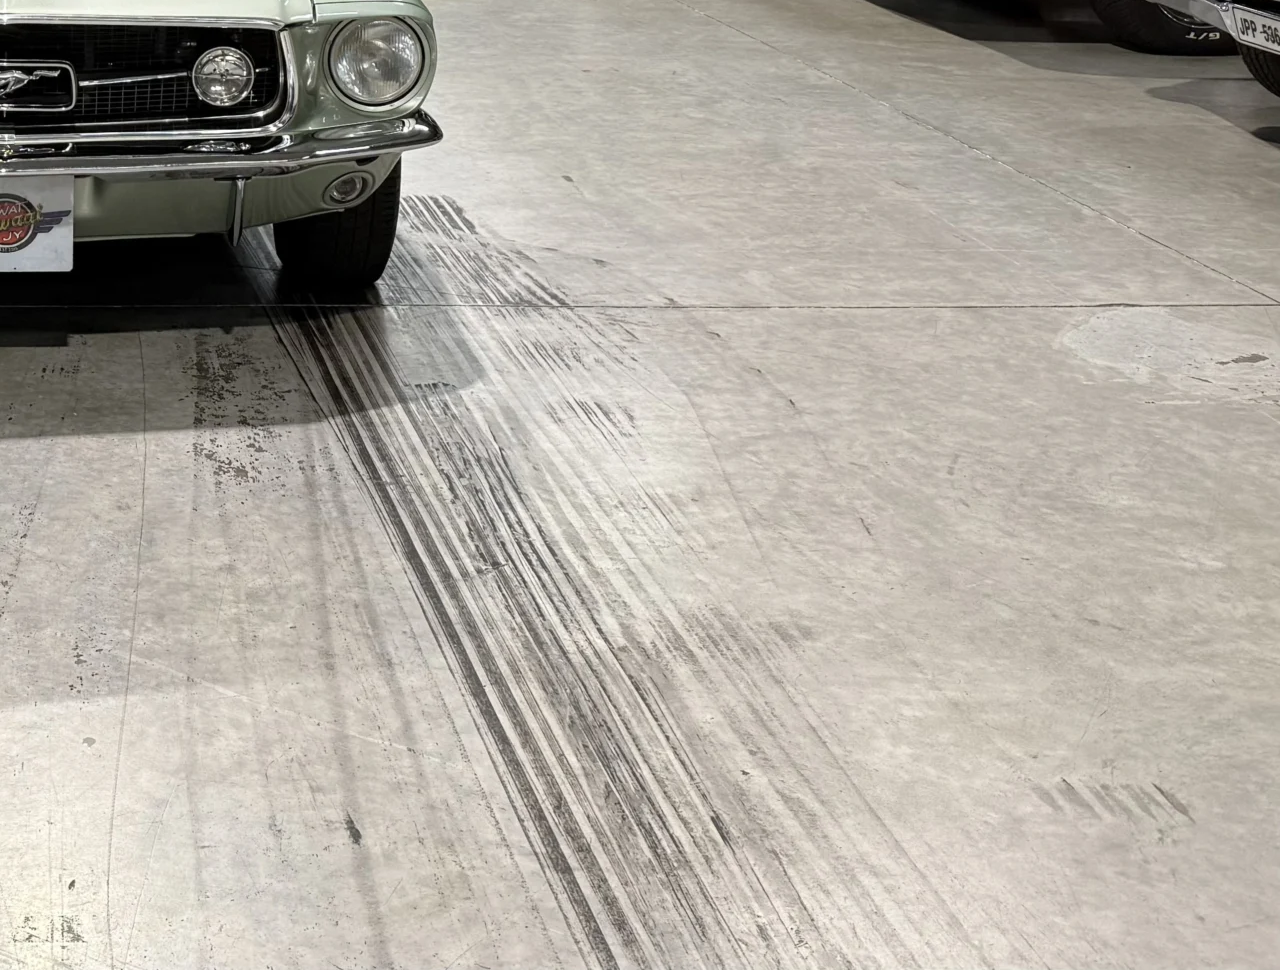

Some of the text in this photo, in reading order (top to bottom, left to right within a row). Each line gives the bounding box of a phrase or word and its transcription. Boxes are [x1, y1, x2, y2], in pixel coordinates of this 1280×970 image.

[1239, 17, 1257, 38] JPP
[1185, 32, 1220, 40] G/T
[2, 230, 23, 241] JY
